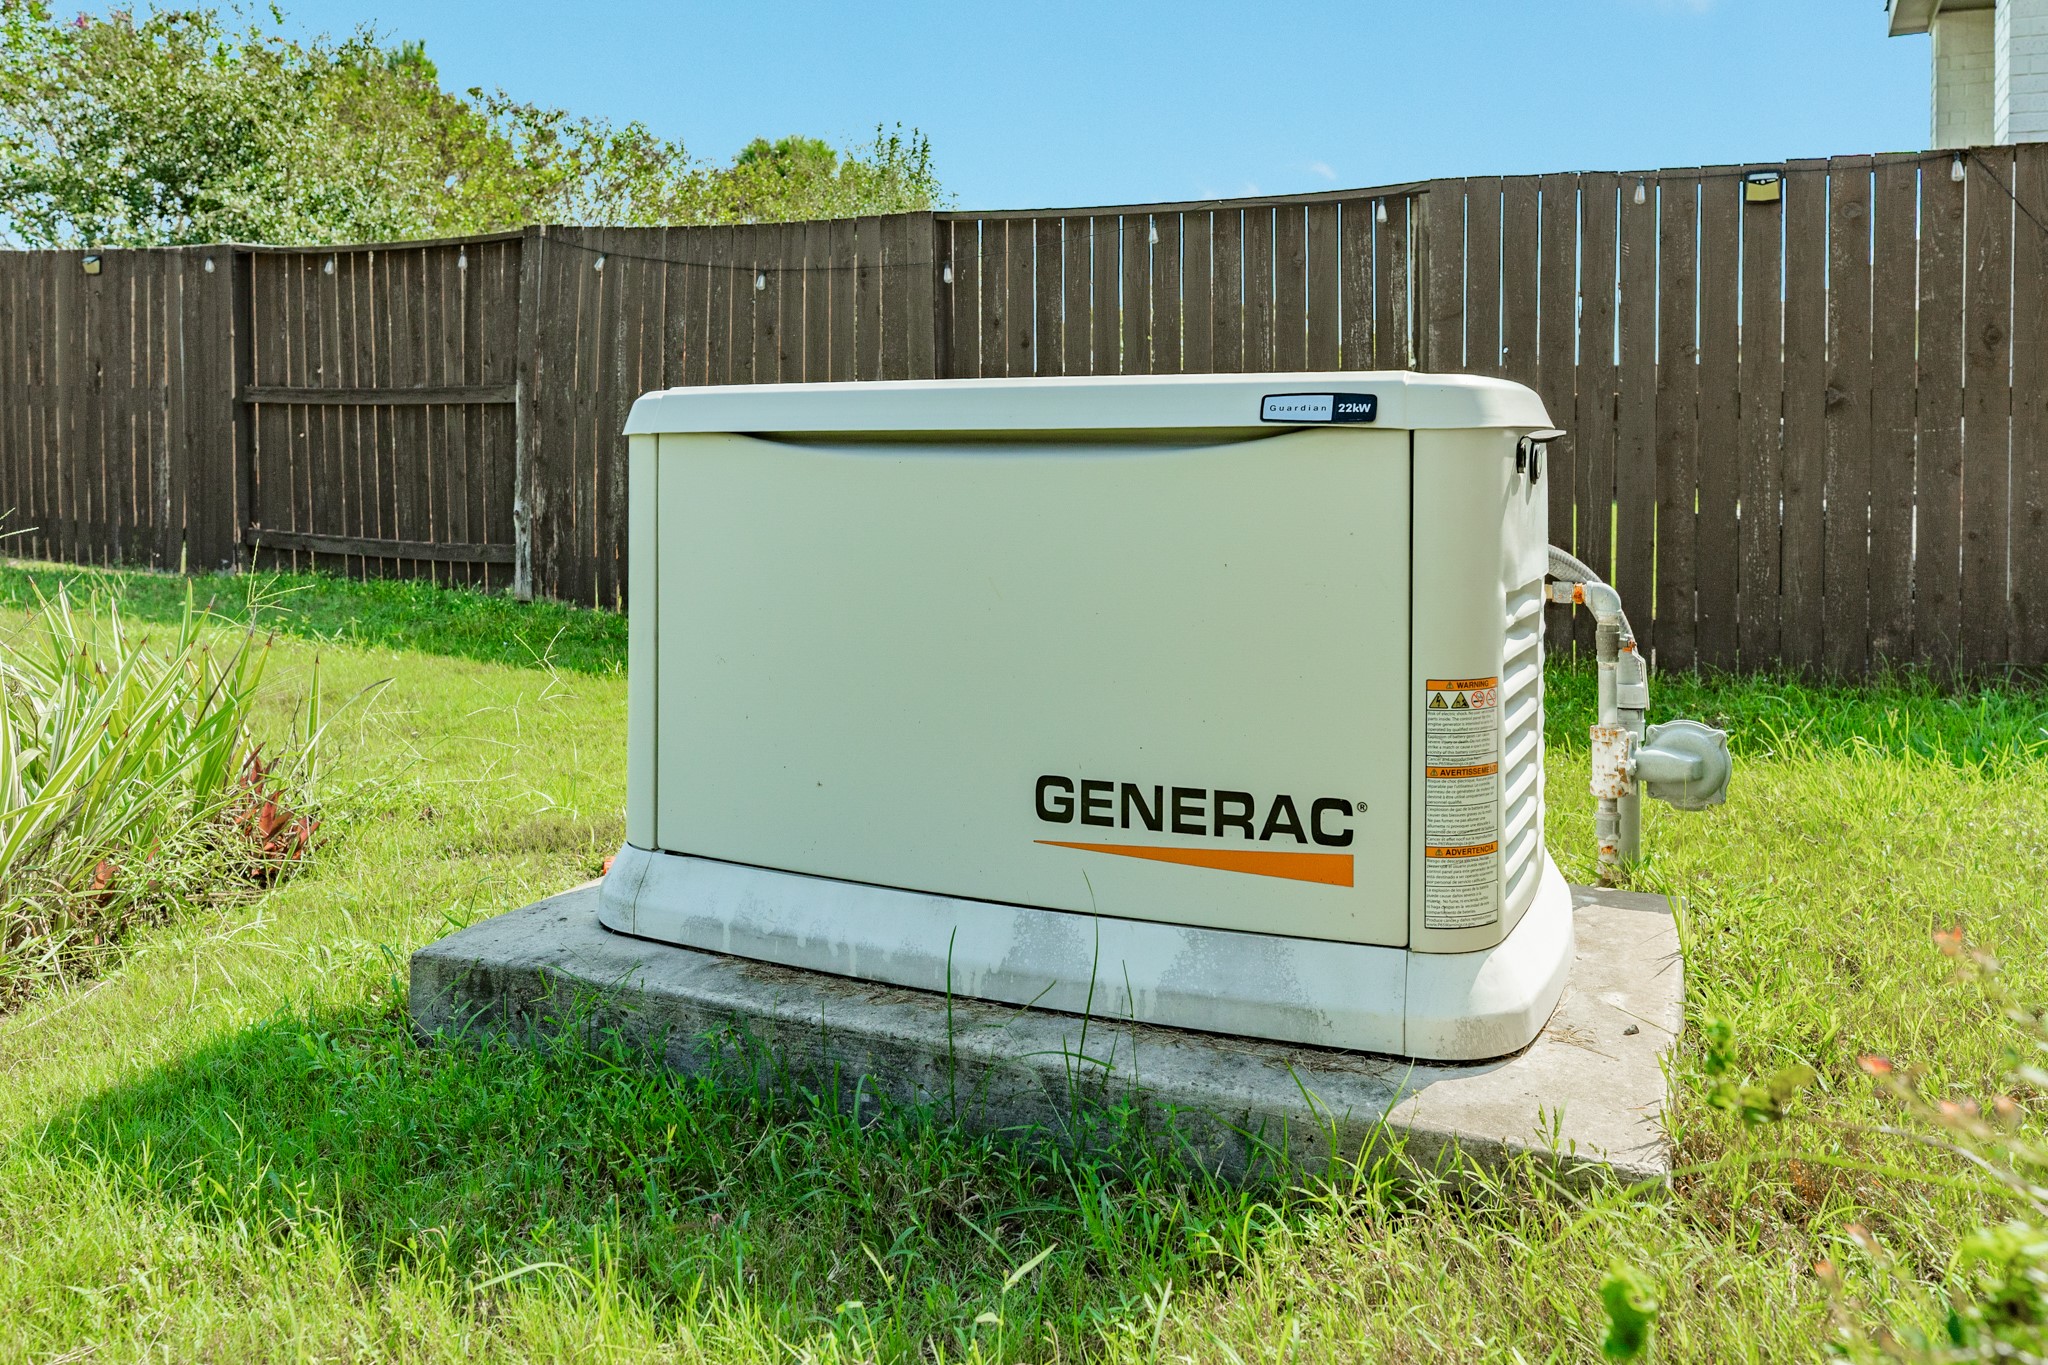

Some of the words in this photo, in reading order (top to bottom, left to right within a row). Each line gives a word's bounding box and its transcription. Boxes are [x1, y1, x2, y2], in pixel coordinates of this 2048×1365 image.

[1269, 404, 1327, 412] Guardian
[1338, 403, 1371, 413] 22kW
[1456, 680, 1489, 689] WARNING
[1440, 765, 1497, 776] AVERTISSEMENT
[1035, 774, 1355, 848] GENERAC
[1445, 844, 1494, 856] ADVERTENCIA
